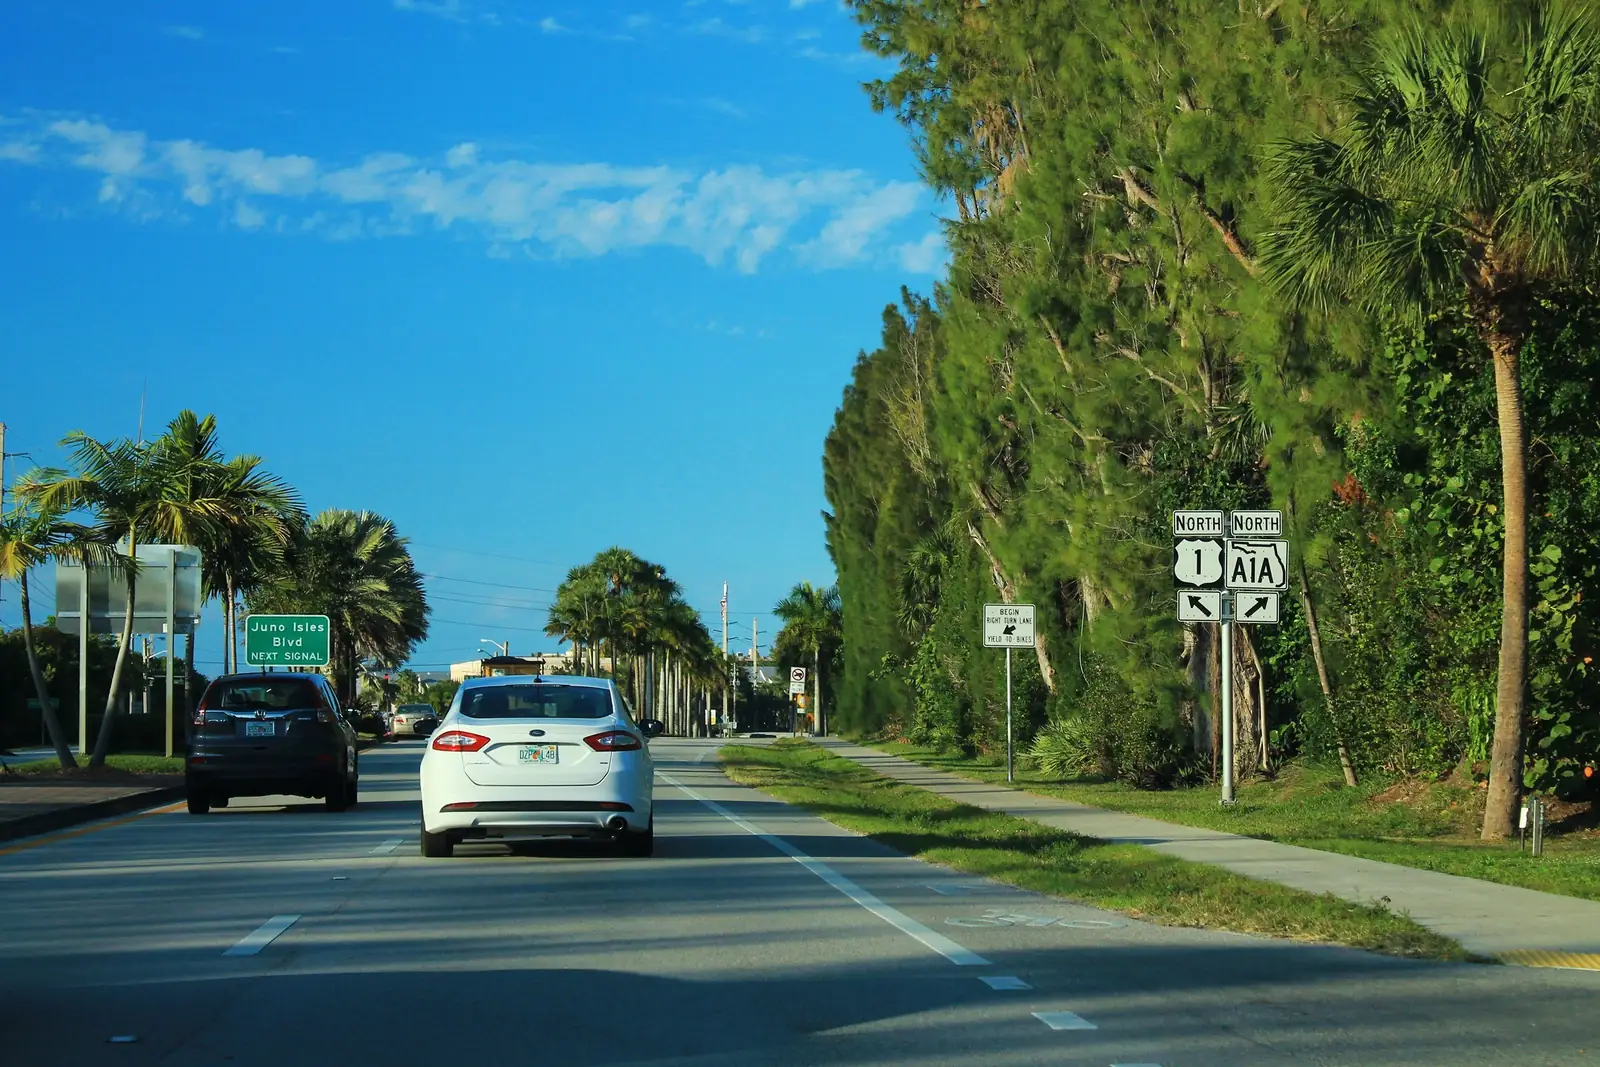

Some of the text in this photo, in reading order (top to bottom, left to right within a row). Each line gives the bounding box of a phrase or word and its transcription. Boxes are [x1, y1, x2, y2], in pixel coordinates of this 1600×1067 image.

[1176, 515, 1220, 530] NORTH
[1234, 515, 1278, 530] NORTH
[1194, 549, 1202, 575] 1
[1231, 556, 1274, 583] A1A
[251, 622, 324, 632] Juno Isles
[272, 637, 302, 647] Blvd
[1016, 636, 1032, 644] BIKES
[251, 652, 324, 660] NEXT SIGNAL
